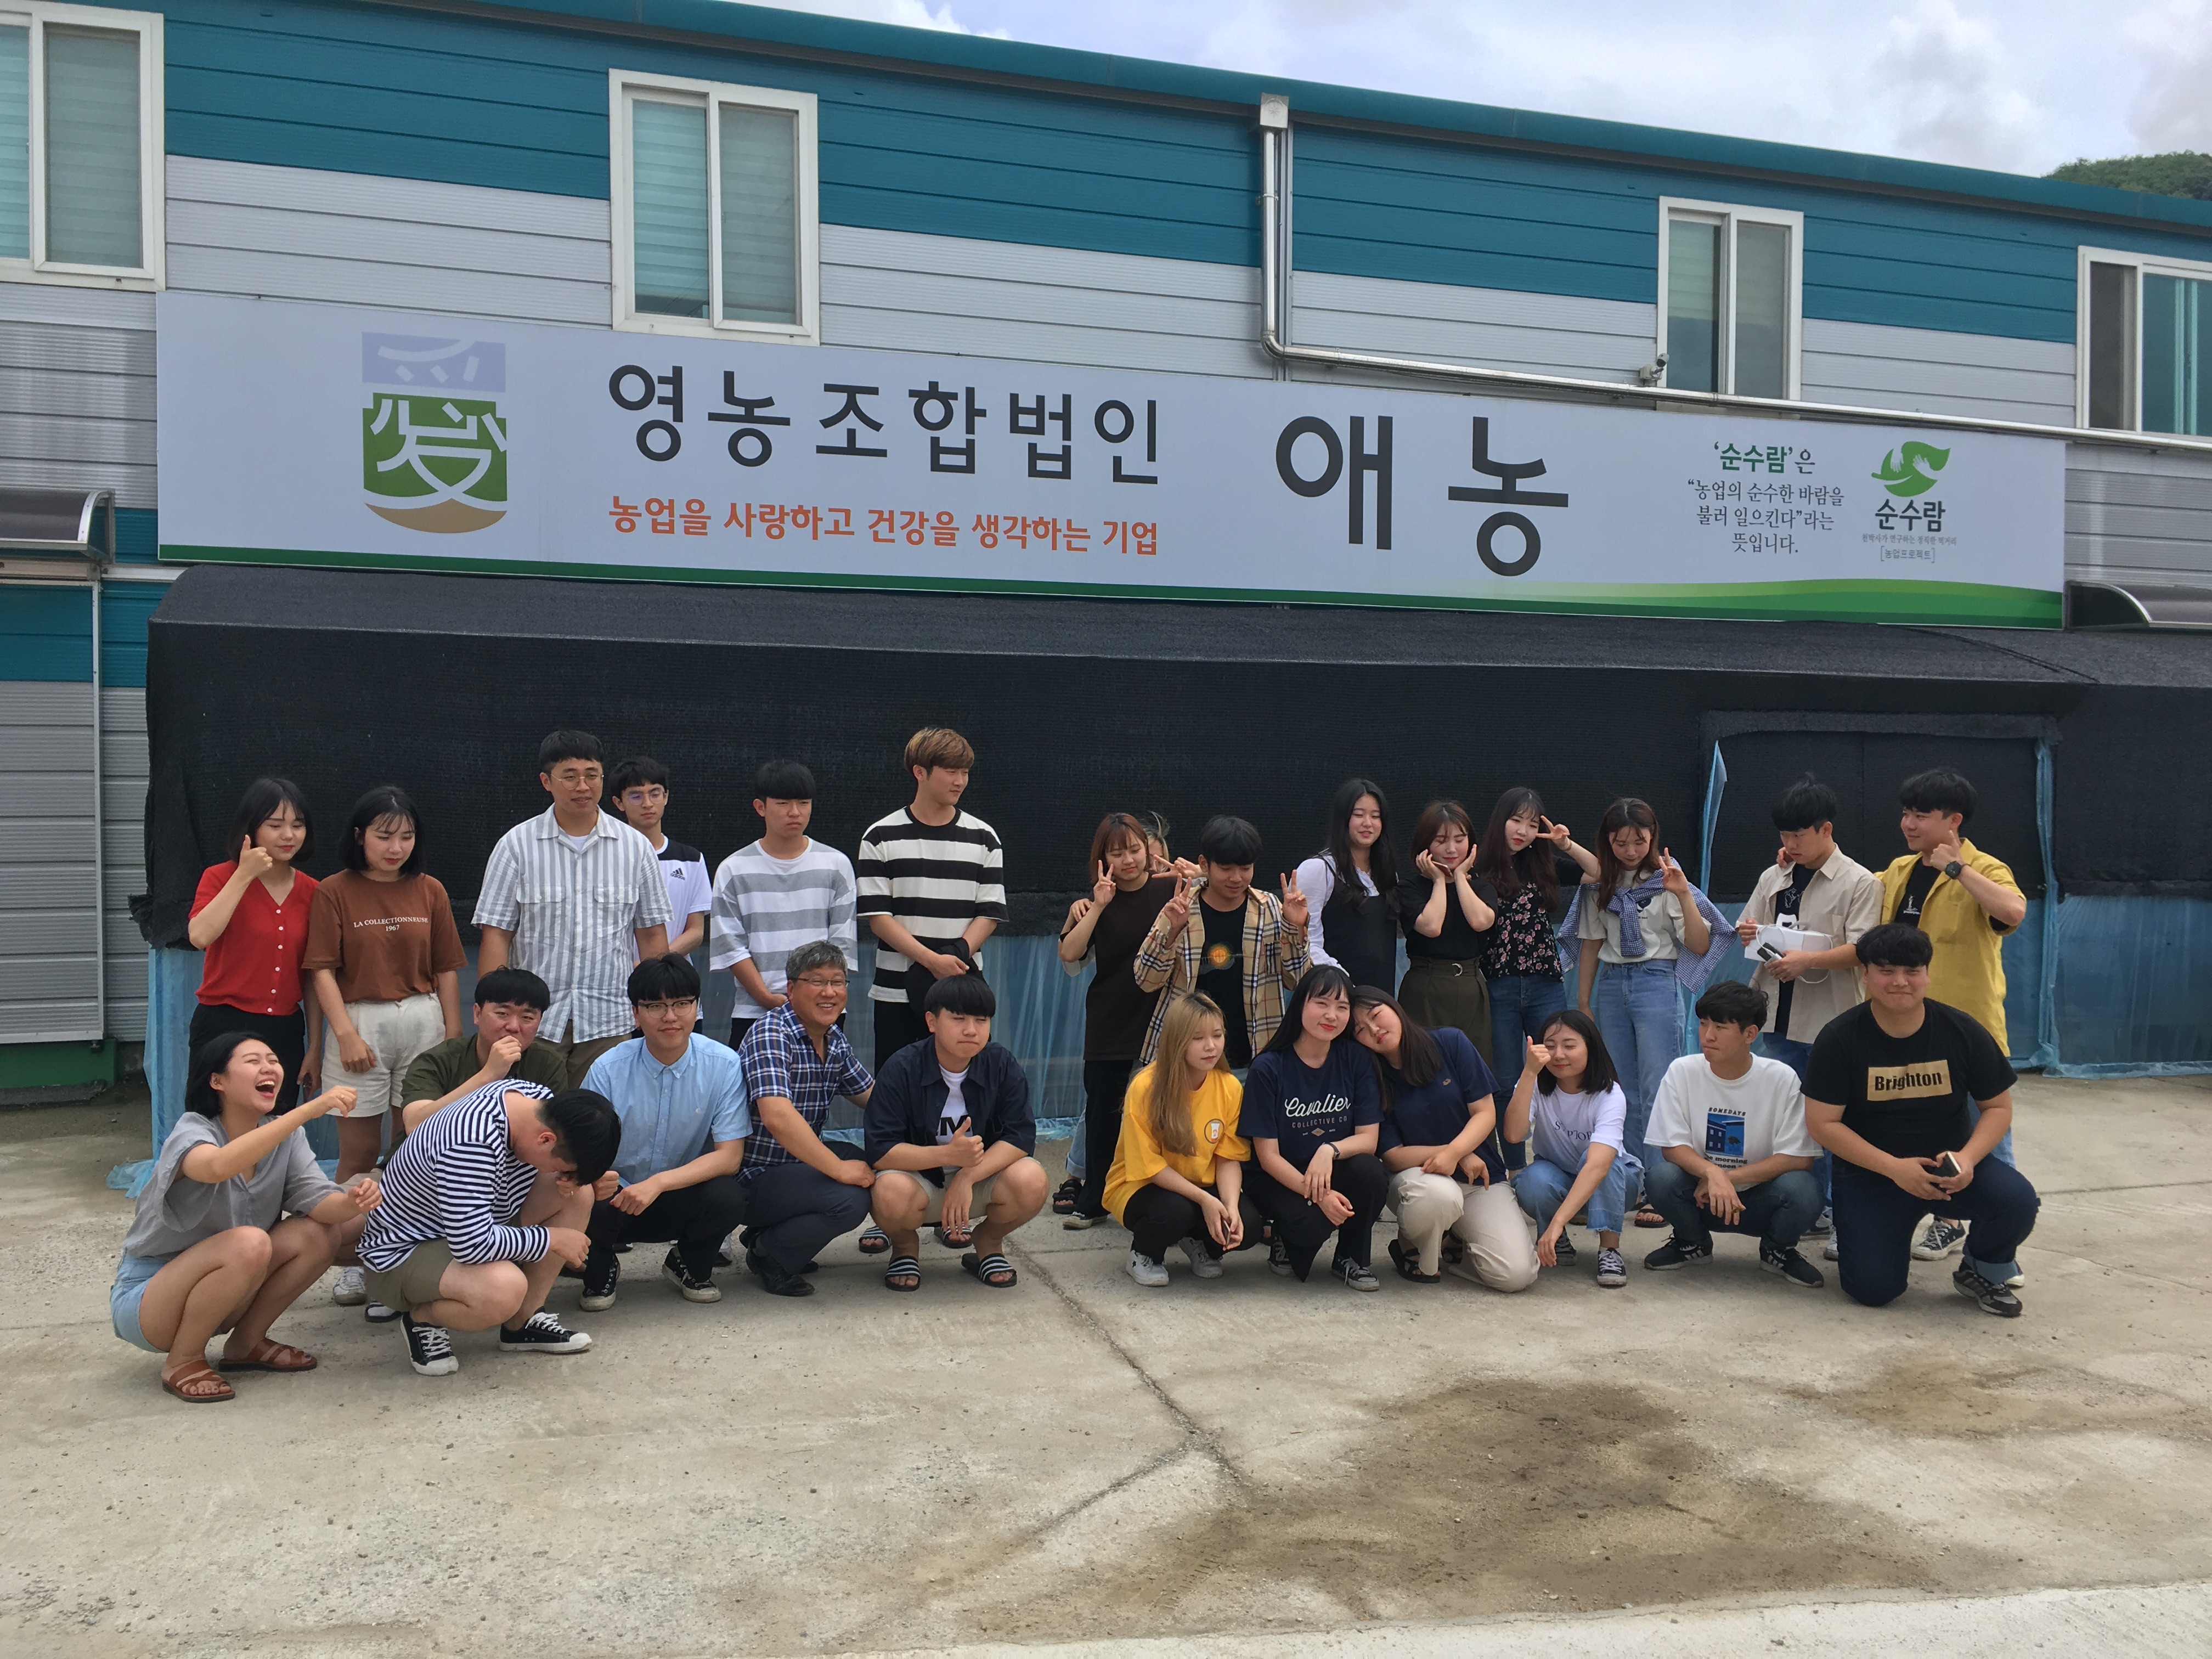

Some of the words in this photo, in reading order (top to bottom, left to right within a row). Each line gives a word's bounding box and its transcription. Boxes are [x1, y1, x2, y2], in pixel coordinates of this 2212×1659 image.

[608, 364, 1158, 485] 영농조합법인
[1276, 415, 1568, 577] 애농
[1747, 483, 1795, 504] 순수한
[1798, 484, 1845, 506] 바람을
[608, 495, 712, 537] 농업을
[723, 502, 855, 540] 사랑하고
[867, 509, 960, 548] 건강을
[971, 514, 1091, 552] 생각하는
[1102, 521, 1157, 556] 기업
[1696, 505, 1728, 527] 불러
[1875, 498, 1946, 532] 순수람
[1731, 532, 1799, 555] 뜻입니다.
[1889, 534, 1916, 544] 연구하는
[364, 917, 429, 926] COLLECTIONNEUSE
[1875, 1072, 1943, 1091] Brighton
[1284, 1093, 1351, 1117] Cavalier
[1708, 1107, 1746, 1116] SOMEDAYS
[1292, 1117, 1335, 1128] COLLECTIVE
